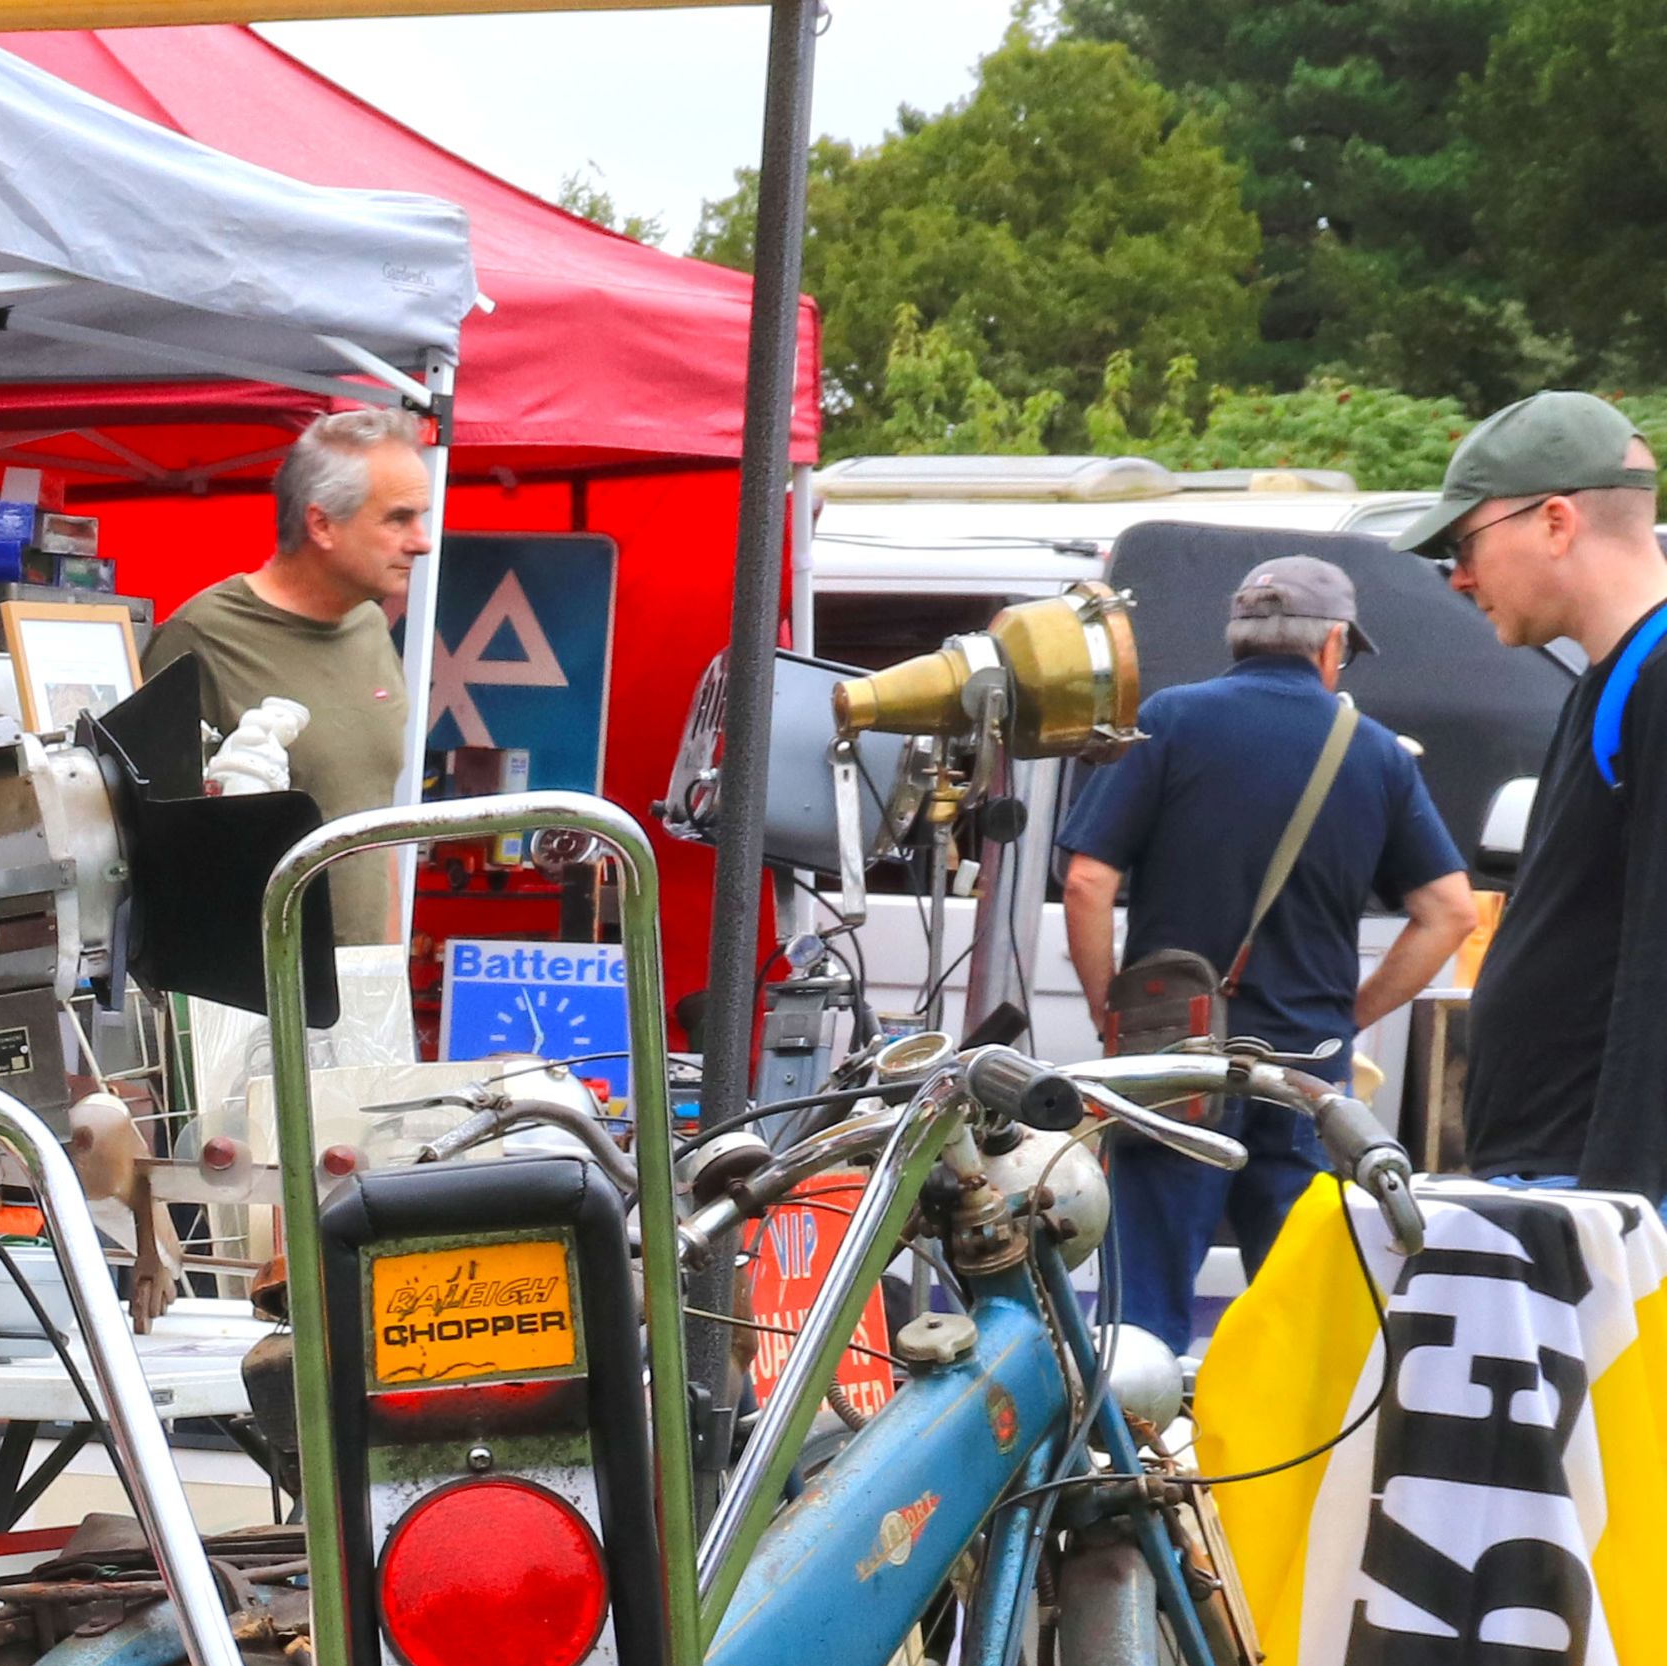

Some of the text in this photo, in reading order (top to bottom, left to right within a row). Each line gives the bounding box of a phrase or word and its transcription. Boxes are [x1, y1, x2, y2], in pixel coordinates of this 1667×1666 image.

[768, 1211, 819, 1281] VIP
[384, 1276, 560, 1318] RALEIGH
[383, 1310, 568, 1347] CHOPPER
